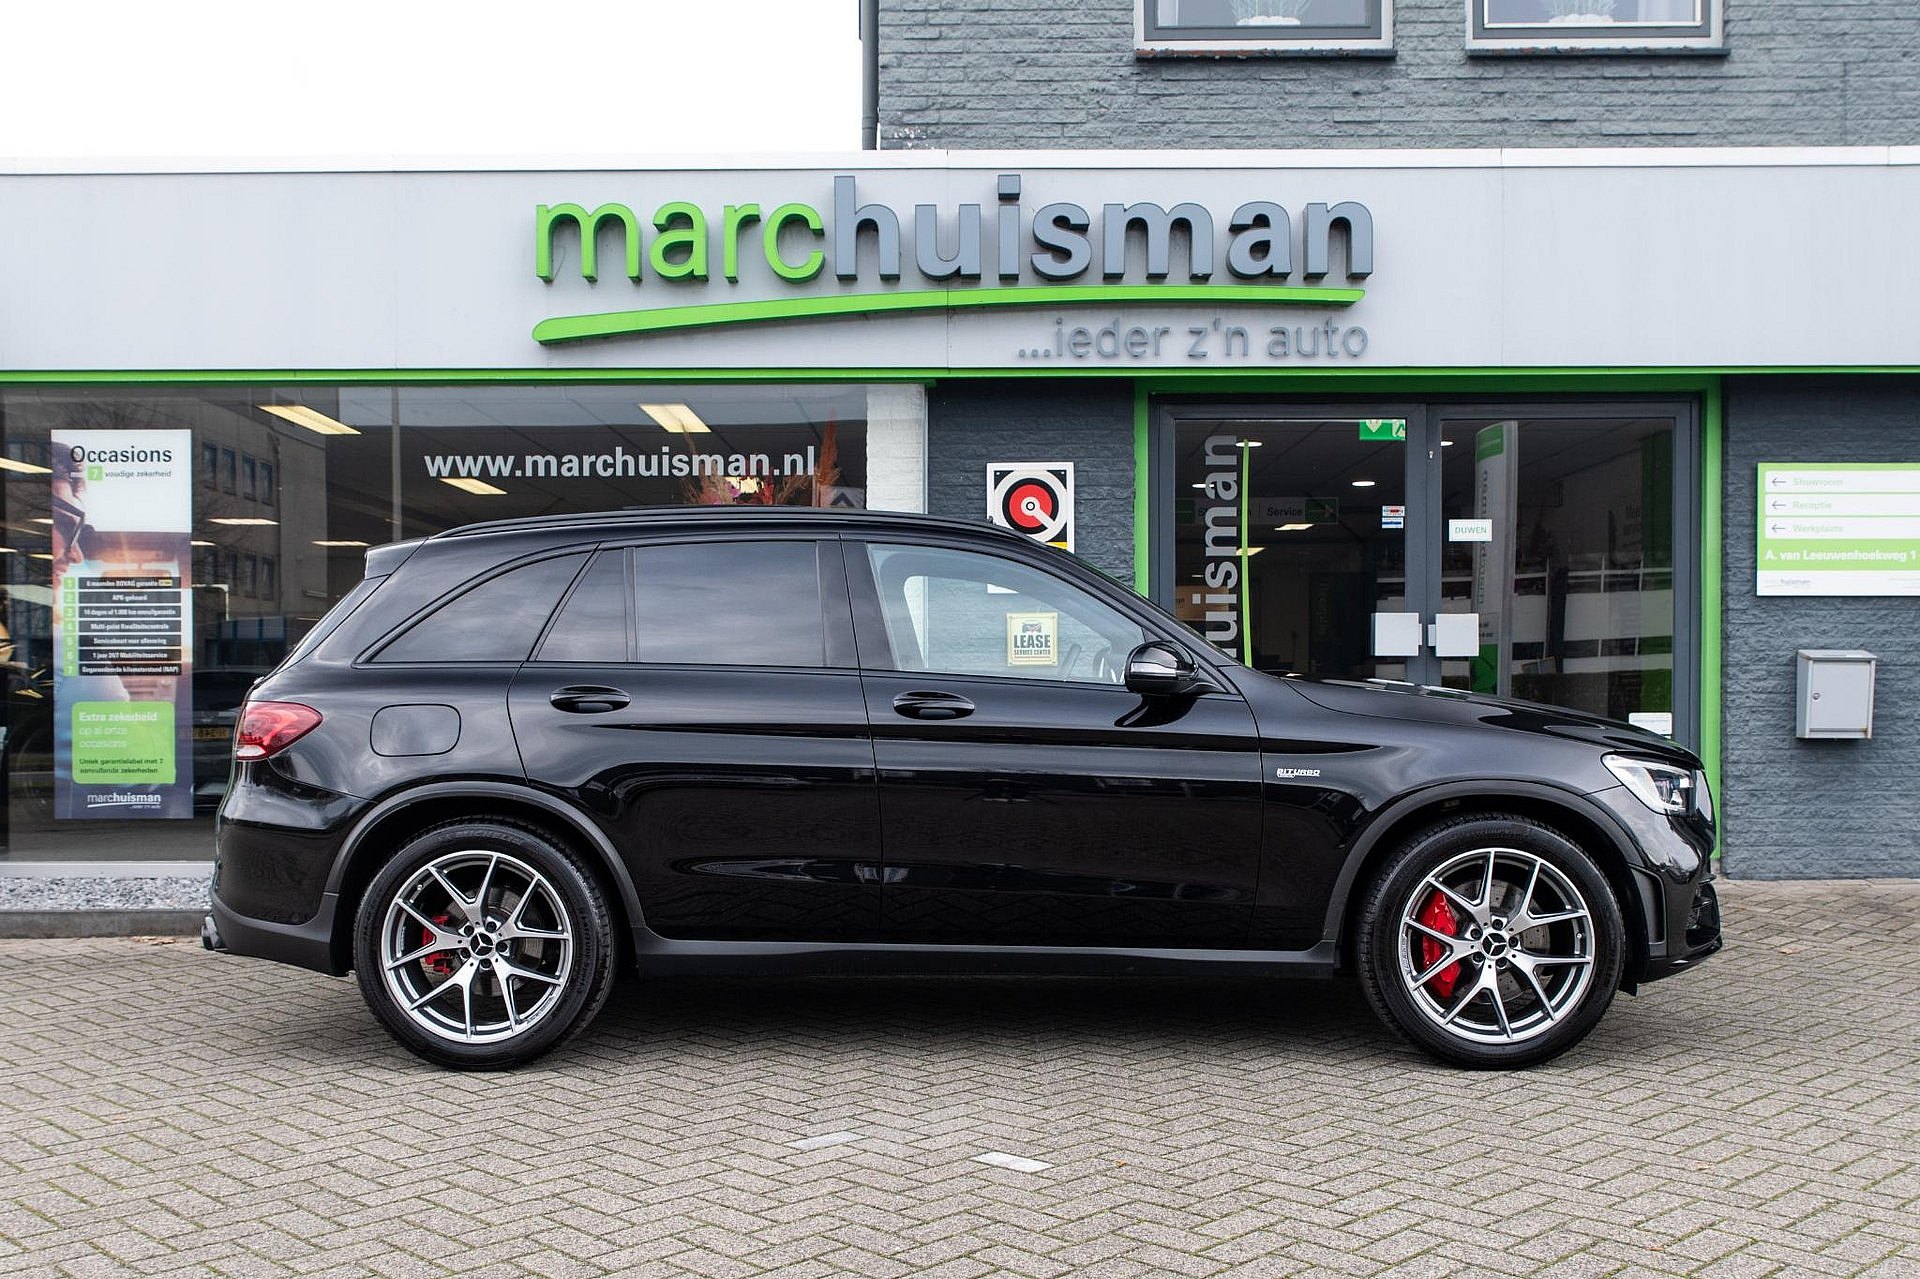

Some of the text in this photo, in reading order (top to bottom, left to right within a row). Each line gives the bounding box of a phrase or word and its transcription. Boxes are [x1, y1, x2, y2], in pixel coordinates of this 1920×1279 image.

[535, 174, 1374, 284] marchuisman
[1187, 318, 1250, 359] z'n
[1267, 318, 1370, 359] auto
[71, 445, 173, 463] Occasions
[424, 446, 816, 478] www.marchuisman.nl
[1266, 506, 1304, 517] Service
[1454, 526, 1487, 534] DUWEN
[1192, 434, 1239, 659] uisman
[1780, 552, 1800, 561] van
[1013, 634, 1051, 649] LEASE
[87, 791, 162, 803] marchuisman
